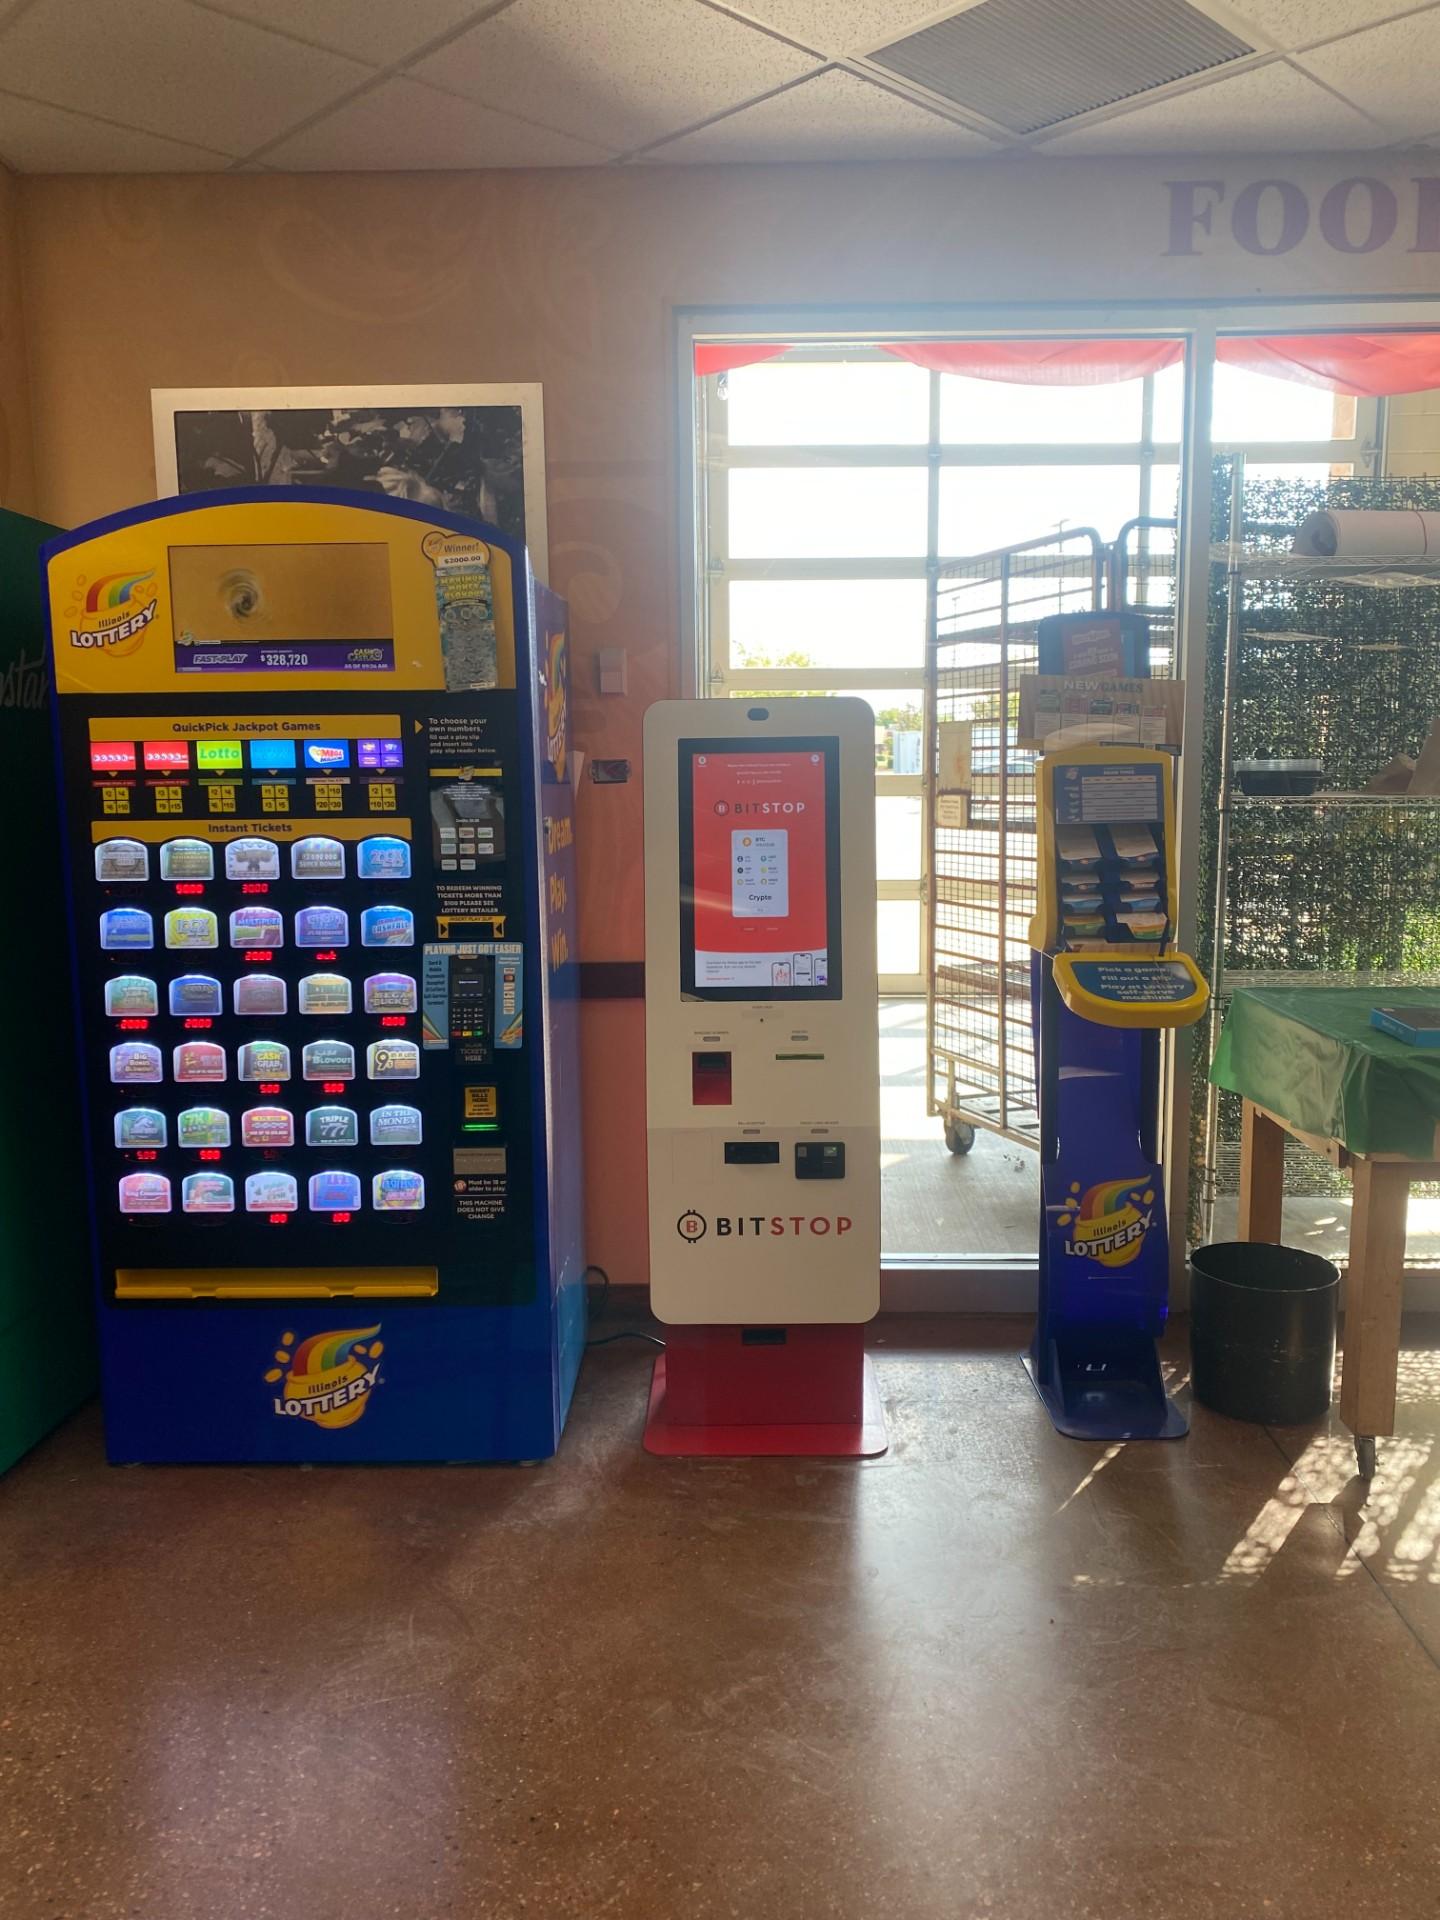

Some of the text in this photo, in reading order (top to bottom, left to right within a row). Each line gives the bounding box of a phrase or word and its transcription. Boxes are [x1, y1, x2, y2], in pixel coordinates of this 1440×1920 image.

[444, 542, 480, 553] Winner!
[70, 599, 157, 648] LOTTERY
[99, 611, 130, 629] Illinois
[261, 654, 308, 666] $328,720
[1063, 679, 1099, 691] NEW
[172, 721, 321, 733] QuickPick Jackpot Games
[429, 717, 487, 726] To choose your
[447, 725, 483, 733] numbers,
[199, 748, 240, 759] Lotto
[735, 802, 806, 815] BITSTOP
[208, 823, 293, 832] Instant Tickets
[424, 944, 522, 955] PLAYING JUST GOT EASIER
[320, 1115, 350, 1124] TRIPLE
[378, 1116, 417, 1127] MONEY
[320, 1124, 348, 1137] 777
[717, 1216, 852, 1236] BITSTOP
[1093, 1220, 1126, 1237] Illinois
[1065, 1209, 1152, 1256] LOTTERY
[274, 1363, 380, 1417] LOTTERY
[308, 1374, 348, 1394] Illinois
